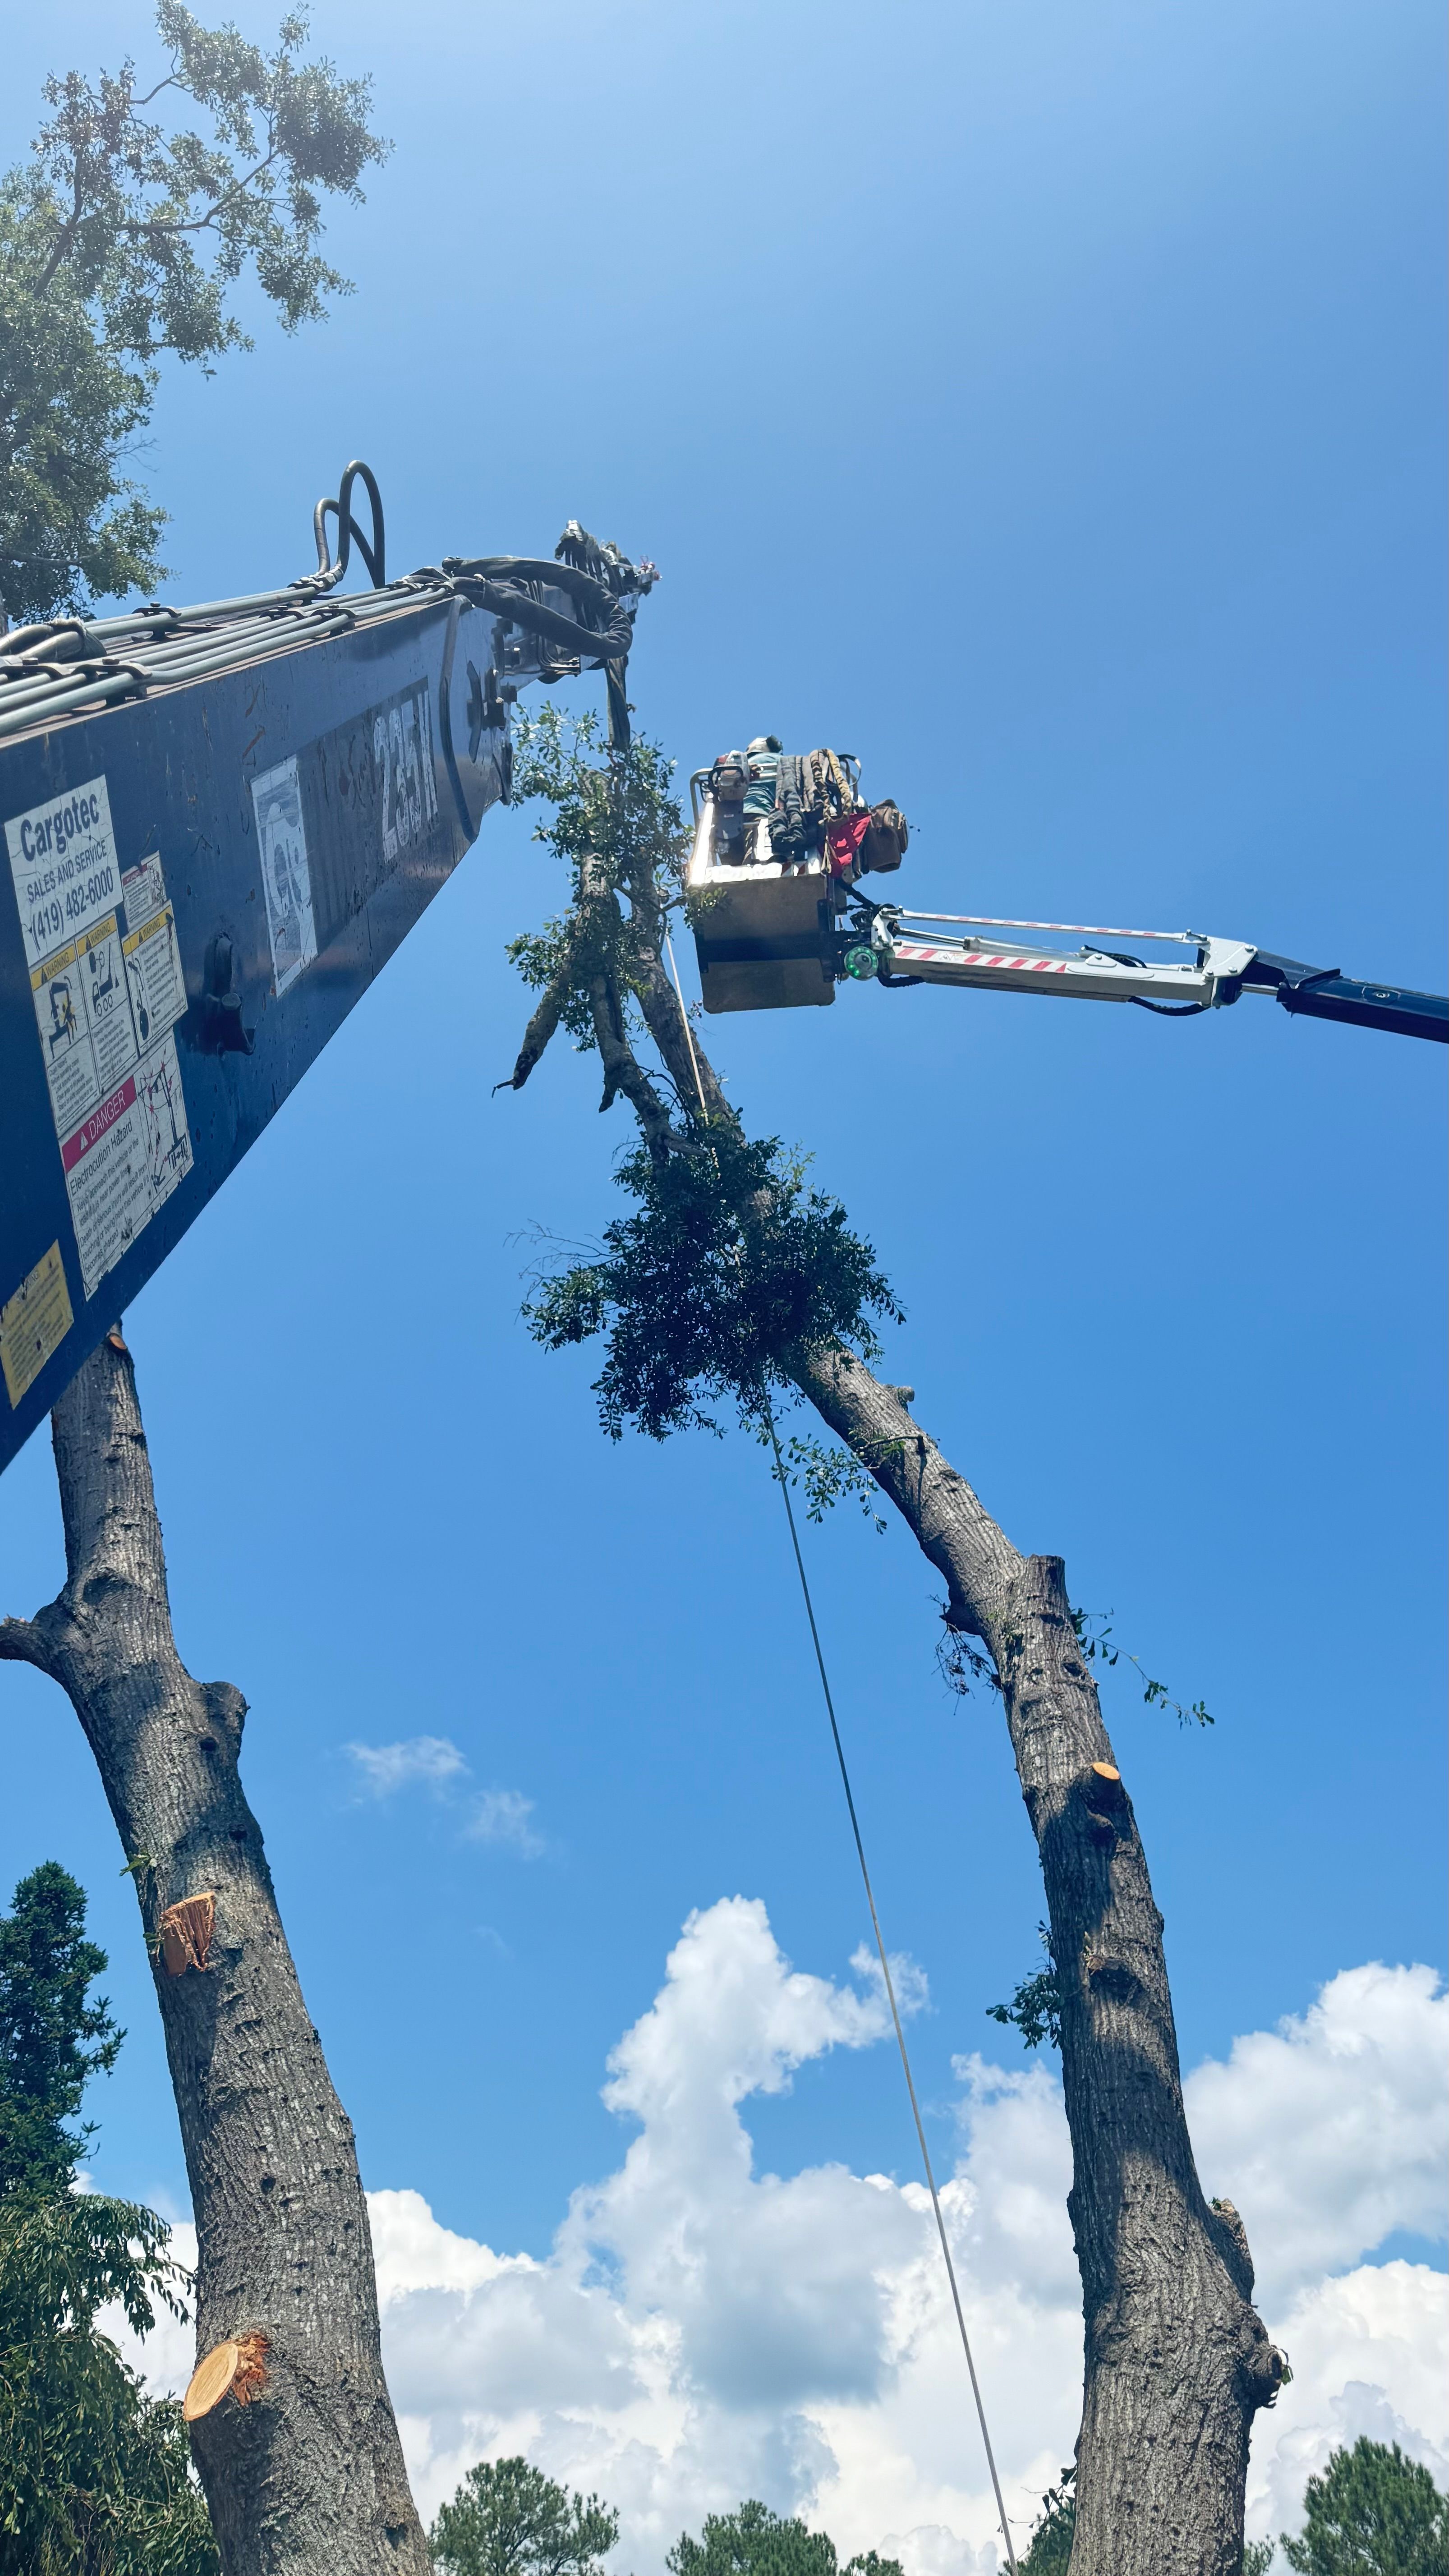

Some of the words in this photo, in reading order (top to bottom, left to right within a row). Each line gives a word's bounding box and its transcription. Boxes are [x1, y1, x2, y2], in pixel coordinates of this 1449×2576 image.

[21, 794, 99, 861] Cargotec
[28, 871, 56, 903] SALES
[58, 860, 74, 885] AND
[75, 839, 106, 873] SERVICE
[32, 899, 64, 951] (419)
[66, 866, 113, 920] 482-6000
[90, 922, 110, 944] WARNING
[143, 918, 161, 938] WARNING
[46, 952, 69, 975] WARNING
[89, 1090, 125, 1140] DANGER
[70, 1145, 111, 1197] Electrocution
[111, 1118, 132, 1151] Hazard
[80, 1228, 92, 1247] Death
[92, 1221, 97, 1231] or
[97, 1205, 111, 1225] serious
[138, 1163, 147, 1179] from
[90, 1173, 108, 1199] approach
[109, 1175, 120, 1194] power
[83, 1237, 100, 1261] touching
[100, 1230, 104, 1240] or
[104, 1218, 115, 1235] being
[131, 1183, 143, 1202] vehicle
[85, 1249, 103, 1275] becomes
